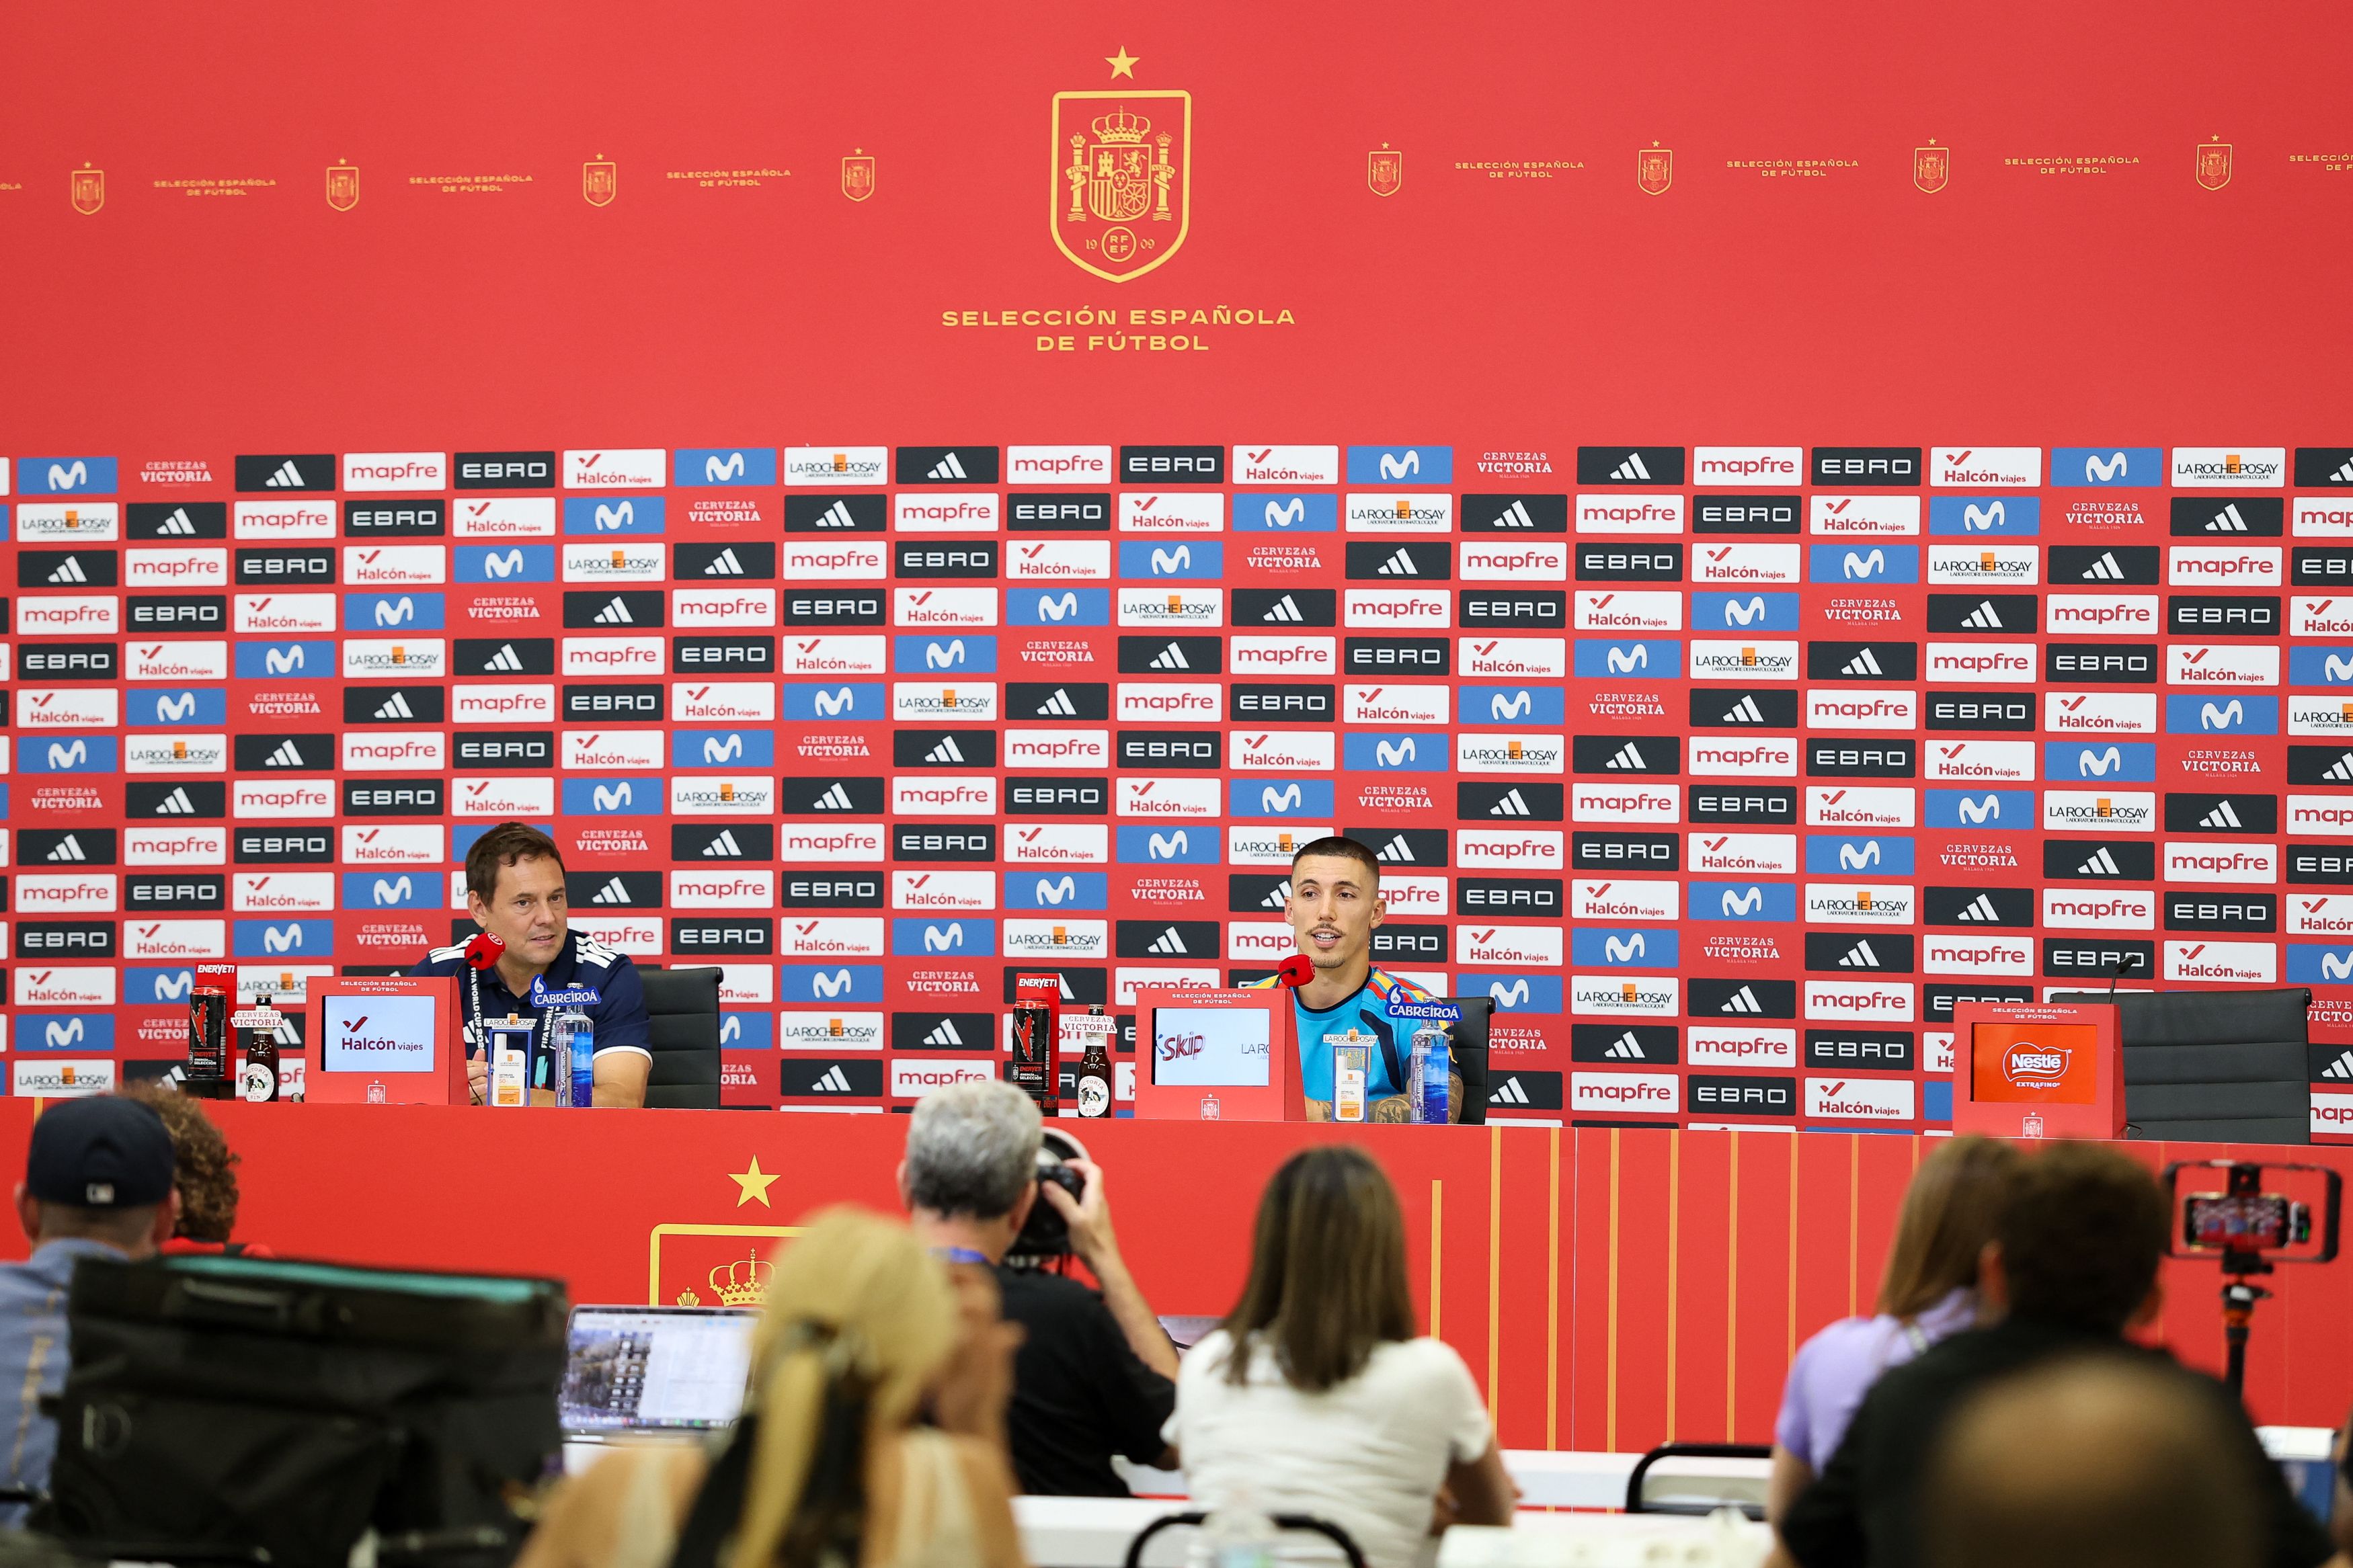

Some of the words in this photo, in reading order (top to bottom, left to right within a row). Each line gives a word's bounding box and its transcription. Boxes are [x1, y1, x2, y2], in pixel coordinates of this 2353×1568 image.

[1726, 159, 1792, 168] SELECCIÓN
[1796, 158, 1859, 167] ESPAÑOLA
[2004, 156, 2072, 165] SELECCIÓN
[2076, 156, 2140, 165] ESPAÑOLA
[2289, 153, 2353, 162] SELECCIÓ
[1455, 161, 1519, 169] SELECCIÓN
[1523, 160, 1585, 169] ESPAÑOLA
[2060, 165, 2107, 174] FÚTBOL
[409, 175, 471, 185] SELECCIÓN
[475, 173, 533, 183] ESPAÑOLA
[667, 171, 729, 179] SELECCIÓN
[731, 169, 791, 177] ESPAÑOLA
[1508, 170, 1553, 178] FÚTBOL
[1781, 169, 1827, 177] FÚTBOL
[153, 179, 215, 188] SELECCIÓN
[218, 177, 276, 187] ESPAÑOLA
[460, 183, 502, 192] FÚTBOL
[204, 188, 247, 196] FÚTBOL
[1086, 239, 1098, 250] 19
[1109, 235, 1129, 243] RF
[1140, 239, 1156, 249] 09
[1109, 245, 1129, 253] EF
[942, 305, 1116, 326] SELECCIÓN
[1130, 305, 1295, 325] ESPAÑOLA
[1037, 336, 1074, 351] DE
[1088, 331, 1209, 351] FÚTBOL
[145, 461, 207, 470] CERVEZAS
[1014, 454, 1103, 474] mapfre
[1129, 457, 1215, 472] EBRO
[1702, 456, 1794, 477] mapfre
[1821, 459, 1911, 474] EBRO
[2178, 464, 2193, 474] LA
[2239, 464, 2278, 474] POSAY
[140, 470, 213, 483] VICTORIA
[352, 462, 438, 481] mapfre
[1945, 470, 1998, 482] Halcón
[2001, 475, 2026, 483] viajes
[2072, 503, 2139, 511] CERVEZAS
[352, 510, 437, 526] EBRO
[1133, 515, 1183, 526] Halcón
[1186, 520, 1209, 528] viajes
[2065, 513, 2145, 524] VICTORIA
[1252, 546, 1316, 556] CERVEZAS
[1246, 556, 1322, 568] VICTORIA
[1933, 561, 1949, 571] LA
[1994, 561, 2032, 571] POSAY
[2177, 556, 2274, 577] mapfre
[358, 568, 406, 579] Halcón
[408, 573, 431, 581] viajes
[1123, 604, 1138, 614] LA
[1180, 604, 1216, 614] POSAY
[2178, 608, 2270, 624] EBRO
[1814, 699, 1908, 720] mapfre
[803, 735, 865, 744] CERVEZAS
[797, 745, 871, 757] VICTORIA
[2188, 750, 2255, 759] CERVEZAS
[2182, 760, 2261, 772] VICTORIA
[2050, 807, 2065, 817] LA
[2110, 808, 2149, 818] POSAY
[1464, 839, 1556, 860] mapfre
[2172, 852, 2269, 873] mapfre
[23, 883, 108, 903] mapfre
[678, 879, 765, 899] mapfre
[790, 882, 875, 897] EBRO
[1466, 889, 1554, 905] EBRO
[2174, 903, 2266, 921] EBRO
[24, 932, 108, 948] EBRO
[795, 940, 844, 951] Halcón
[846, 944, 870, 952] viajes
[198, 964, 235, 975] ENERYETI
[2179, 964, 2233, 977] Halcón
[2235, 971, 2261, 979] viajes
[1019, 978, 1058, 989] ENERYETI
[29, 989, 77, 1000] Halcón
[79, 993, 102, 1001] viajes
[471, 983, 480, 1011] WORLD
[1812, 991, 1906, 1012] mapfre
[233, 1018, 284, 1026] VICTORIA
[543, 1005, 554, 1031] WORL
[1065, 1023, 1116, 1032] VICTORIA
[342, 1037, 395, 1050] Halcón
[398, 1042, 423, 1051] viajes
[475, 1028, 484, 1048] 202
[541, 1032, 549, 1048] FIFA
[1814, 1041, 1905, 1059] EBRO
[2011, 1054, 2061, 1068] Nestlé
